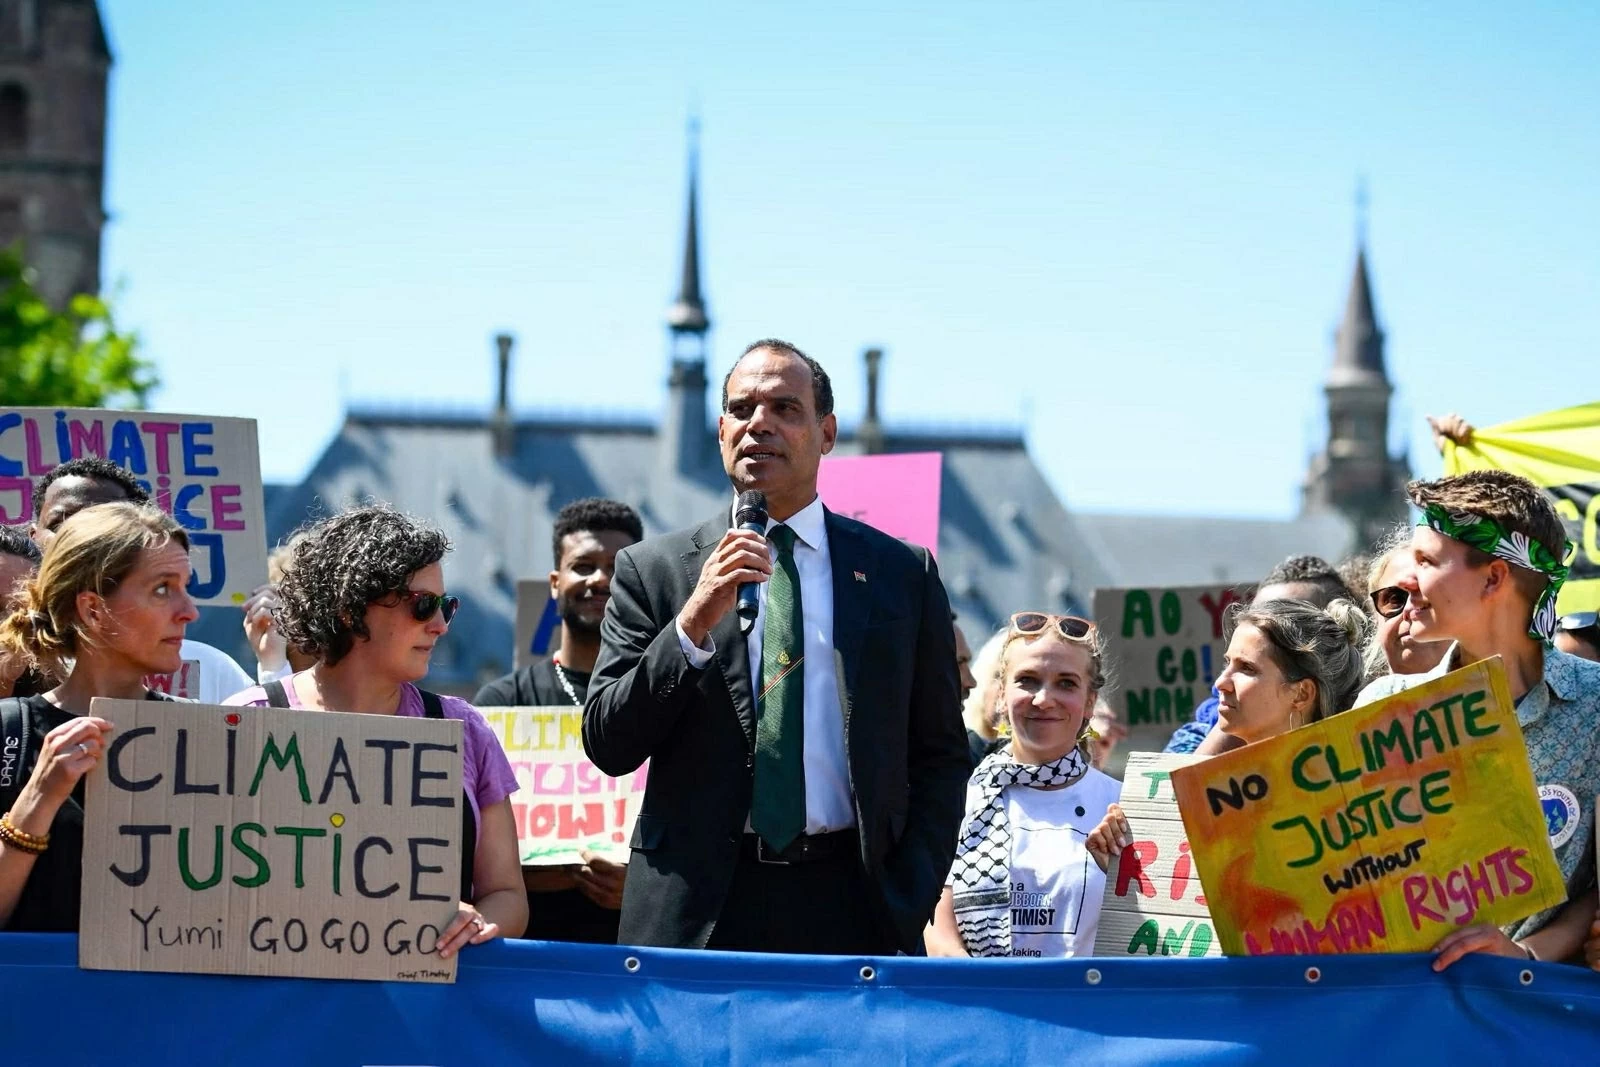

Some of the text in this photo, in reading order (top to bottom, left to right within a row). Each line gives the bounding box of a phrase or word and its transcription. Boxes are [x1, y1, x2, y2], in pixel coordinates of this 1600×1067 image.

[1157, 645, 1213, 685] GO!
[1206, 689, 1500, 816] NO CLIMATE
[1272, 770, 1453, 869] JUSTICE
[1115, 841, 1208, 907] Ri
[1323, 838, 1427, 894] WITHOUT
[130, 906, 440, 956] Yumi GO GO GO
[1010, 908, 1056, 926] TIMIST
